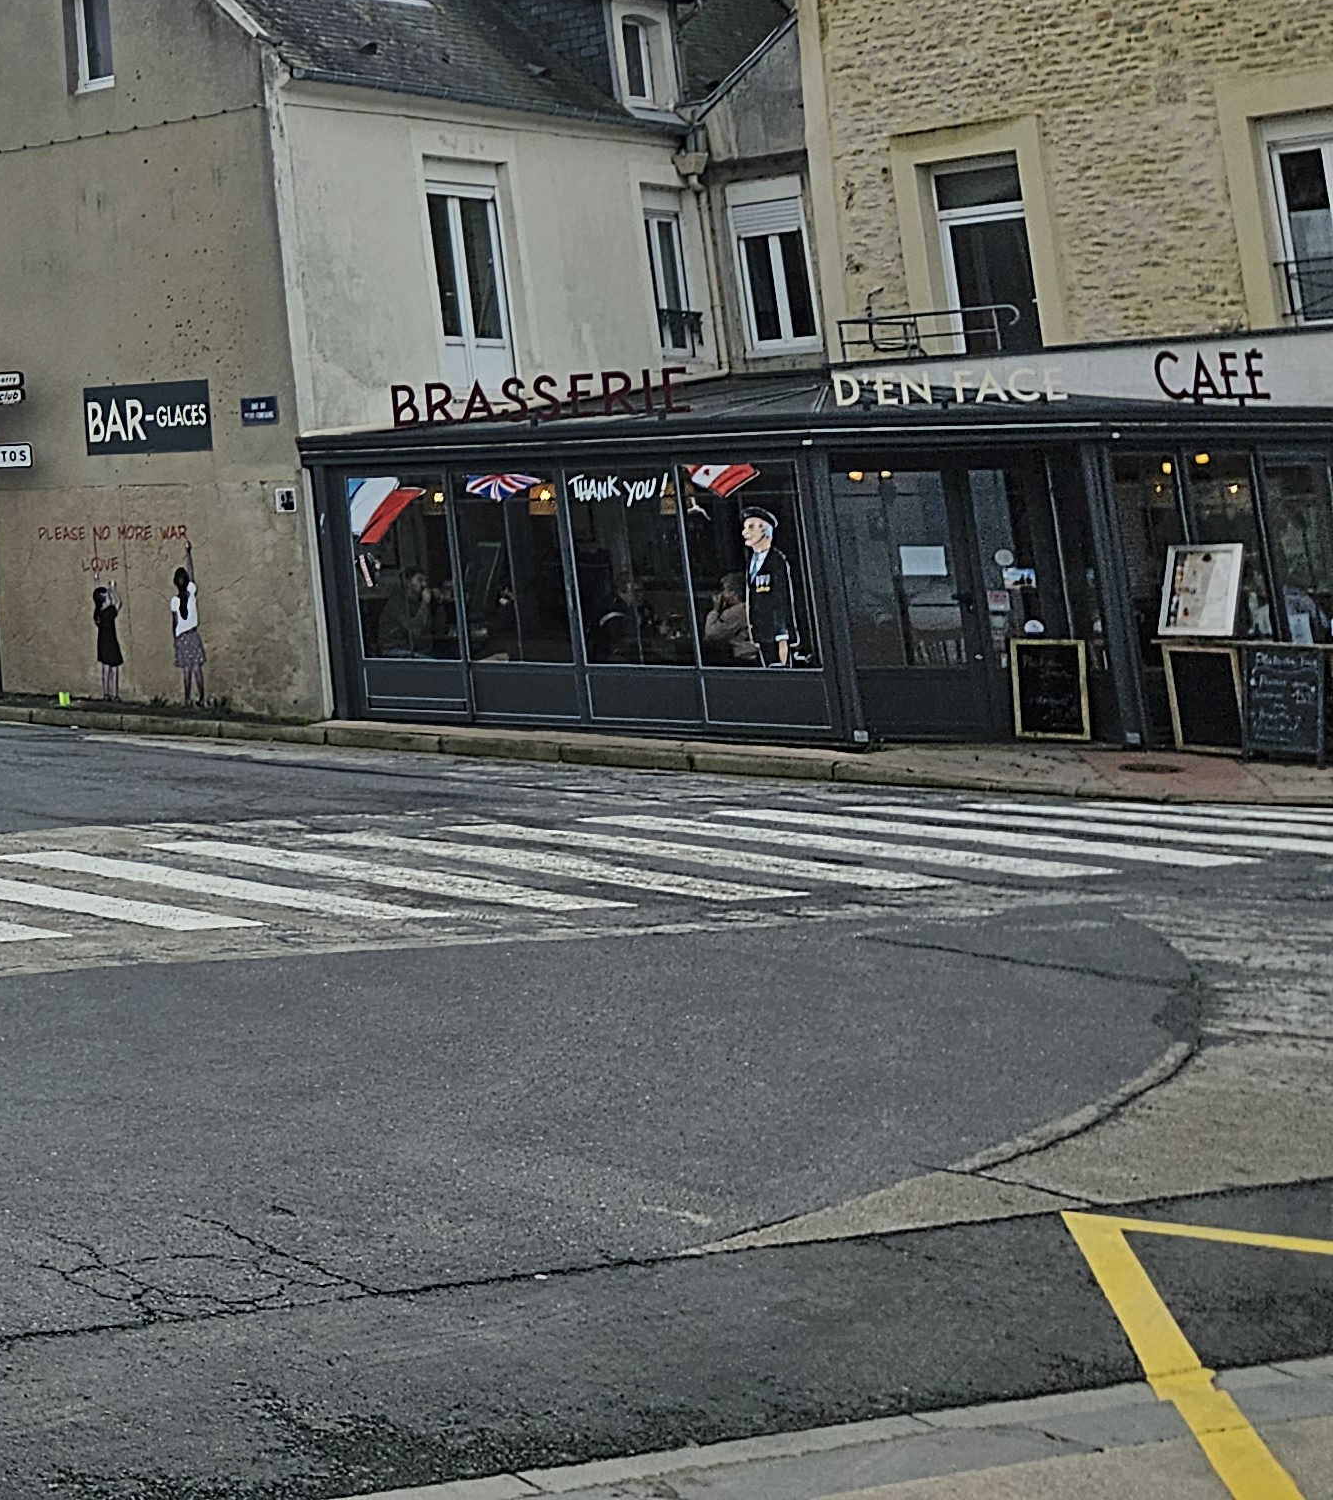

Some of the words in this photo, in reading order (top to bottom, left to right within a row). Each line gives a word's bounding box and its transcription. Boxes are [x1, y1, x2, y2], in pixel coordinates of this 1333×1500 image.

[390, 366, 692, 428] BRASSERIE
[831, 370, 933, 407] D'EN
[952, 367, 1069, 404] FACE
[567, 473, 622, 502] THANK
[623, 477, 657, 508] YOU
[38, 526, 86, 541] PLEASE
[93, 525, 111, 540] NO
[118, 524, 153, 541] MORE
[160, 524, 188, 541] WAR
[81, 556, 119, 572] LOVE
